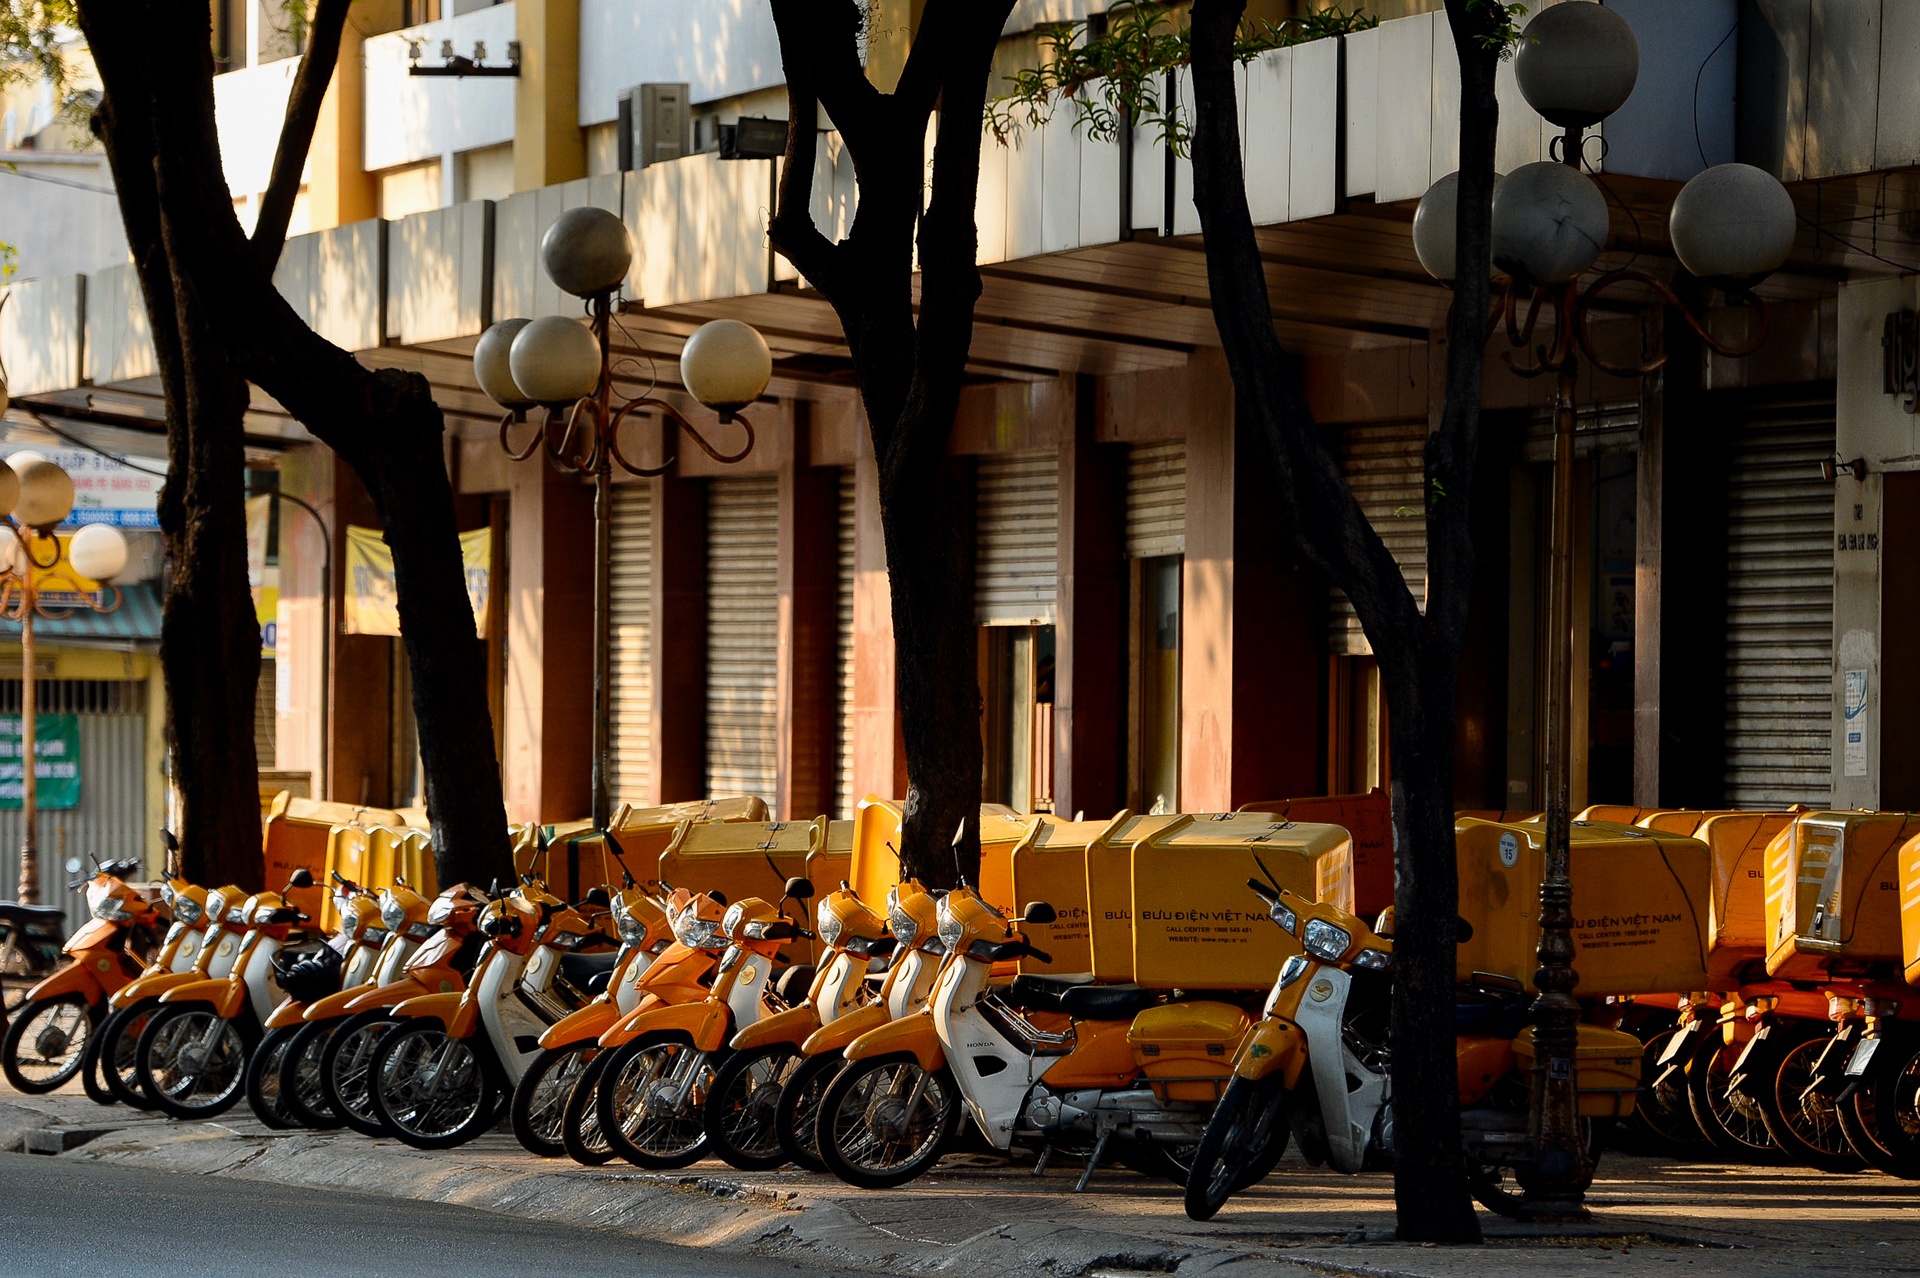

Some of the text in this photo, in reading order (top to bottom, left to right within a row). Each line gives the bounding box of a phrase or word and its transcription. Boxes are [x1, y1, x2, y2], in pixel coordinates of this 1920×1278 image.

[1504, 848, 1513, 860] 15
[1142, 908, 1172, 920] BƯU
[1175, 909, 1209, 923] ĐIỆN
[1211, 908, 1242, 923] VIỆT
[1586, 915, 1619, 930] ĐIỆN
[1621, 913, 1649, 929] VIỆT
[1652, 914, 1681, 923] NAM
[1578, 932, 1594, 940] CALL
